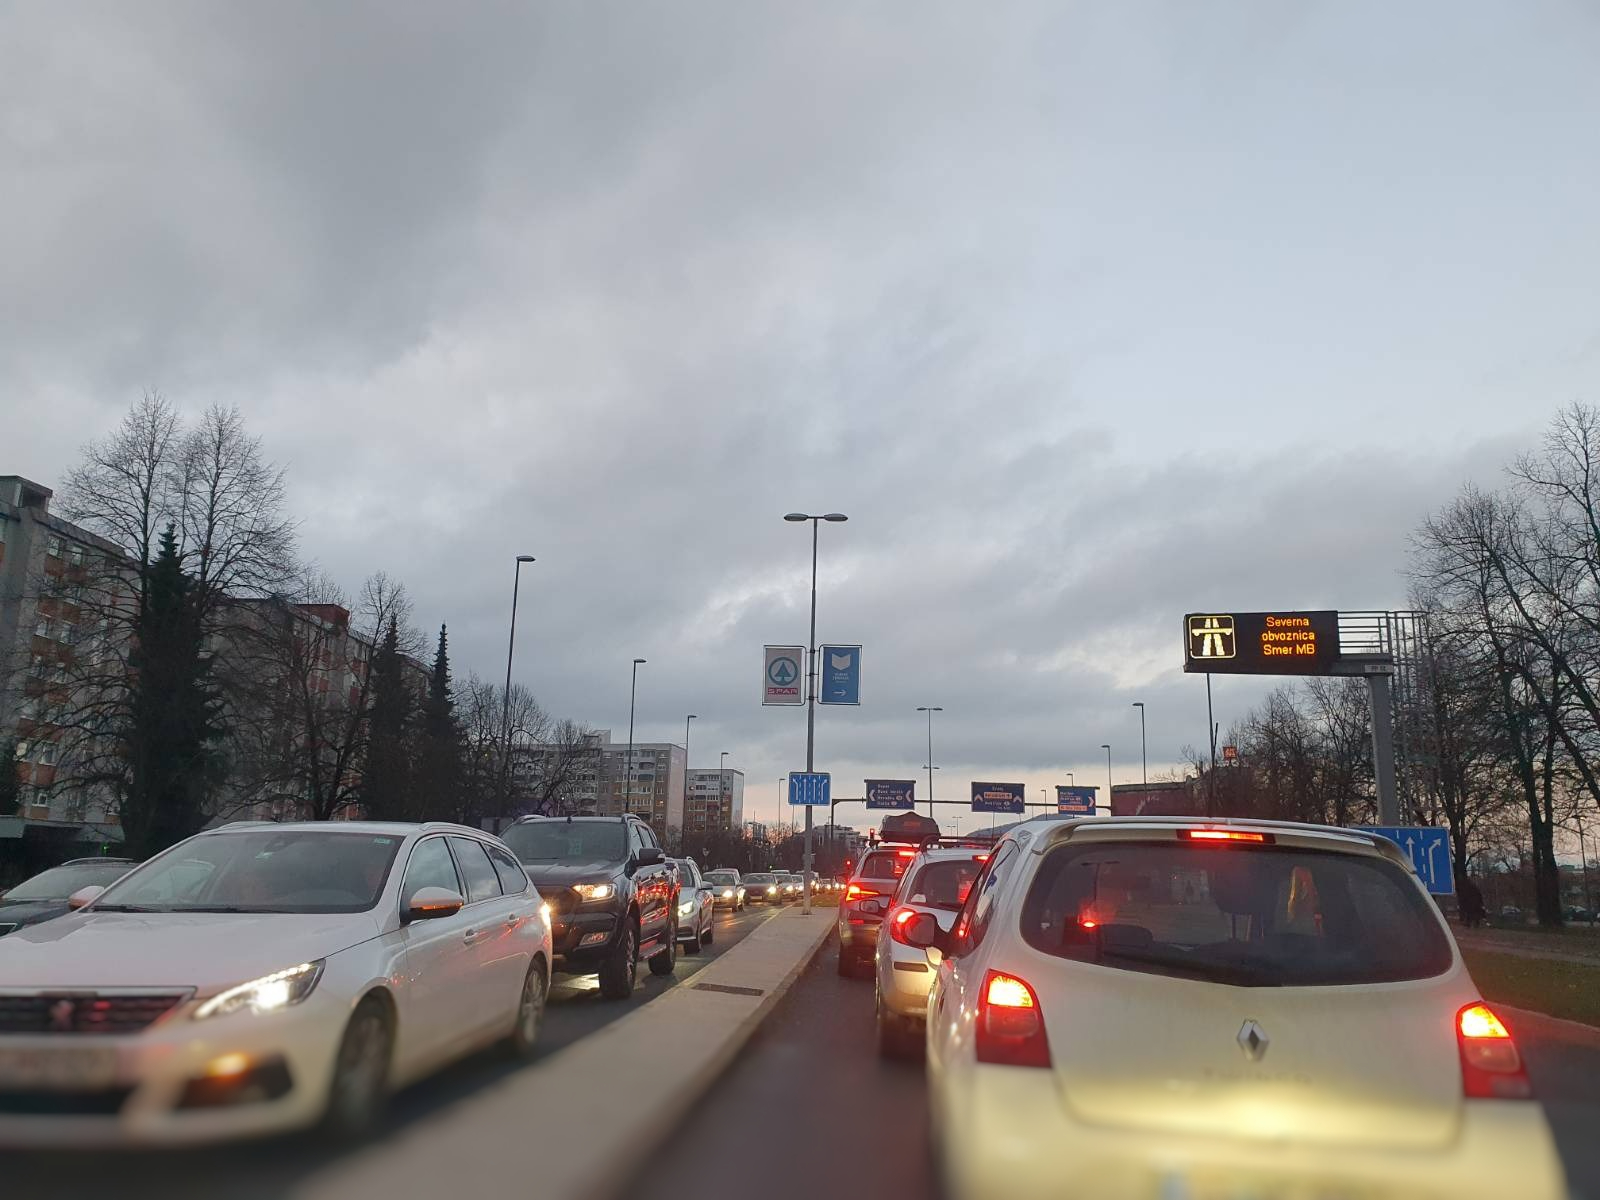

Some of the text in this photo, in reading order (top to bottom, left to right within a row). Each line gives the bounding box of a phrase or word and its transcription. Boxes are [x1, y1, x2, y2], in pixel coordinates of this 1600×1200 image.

[1266, 616, 1310, 627] Severna
[1261, 630, 1315, 641] obvoznica
[1263, 643, 1315, 655] Smer MB
